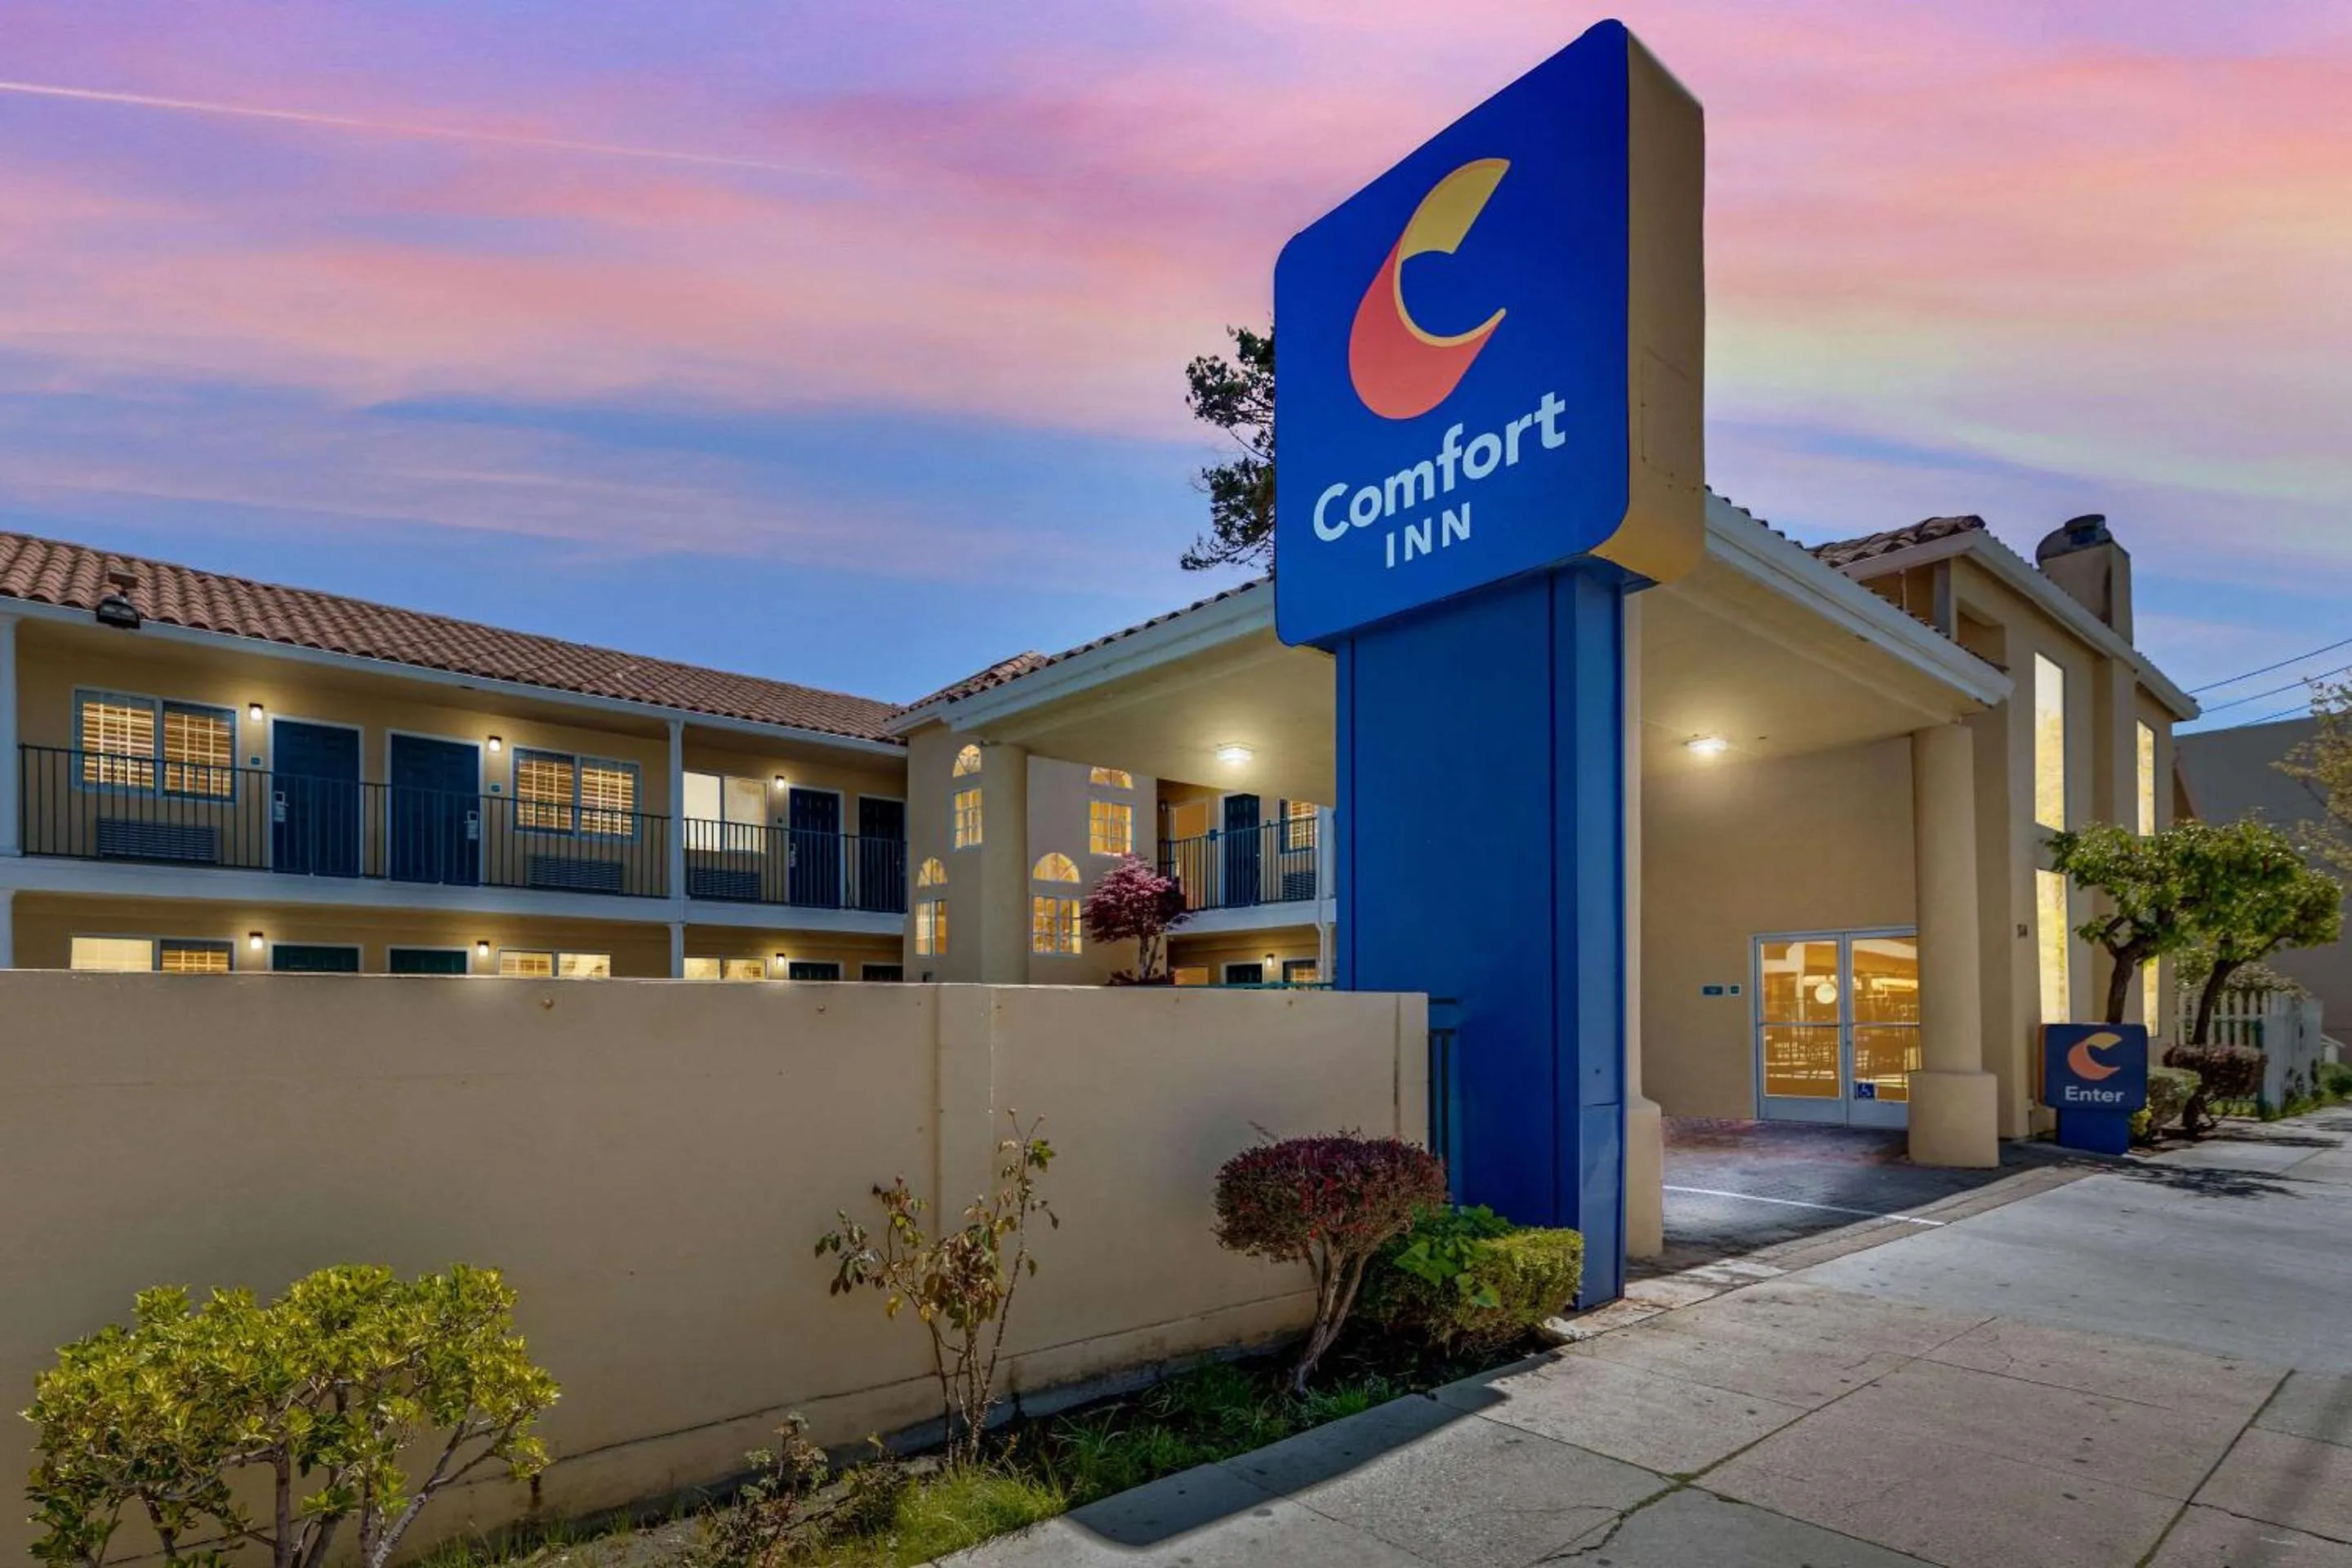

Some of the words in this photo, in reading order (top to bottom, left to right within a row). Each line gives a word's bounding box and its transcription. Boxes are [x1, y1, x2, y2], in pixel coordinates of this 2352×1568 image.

[1313, 391, 1566, 541] Comfort
[1386, 501, 1470, 568] INN
[2065, 1085, 2124, 1103] Enter
